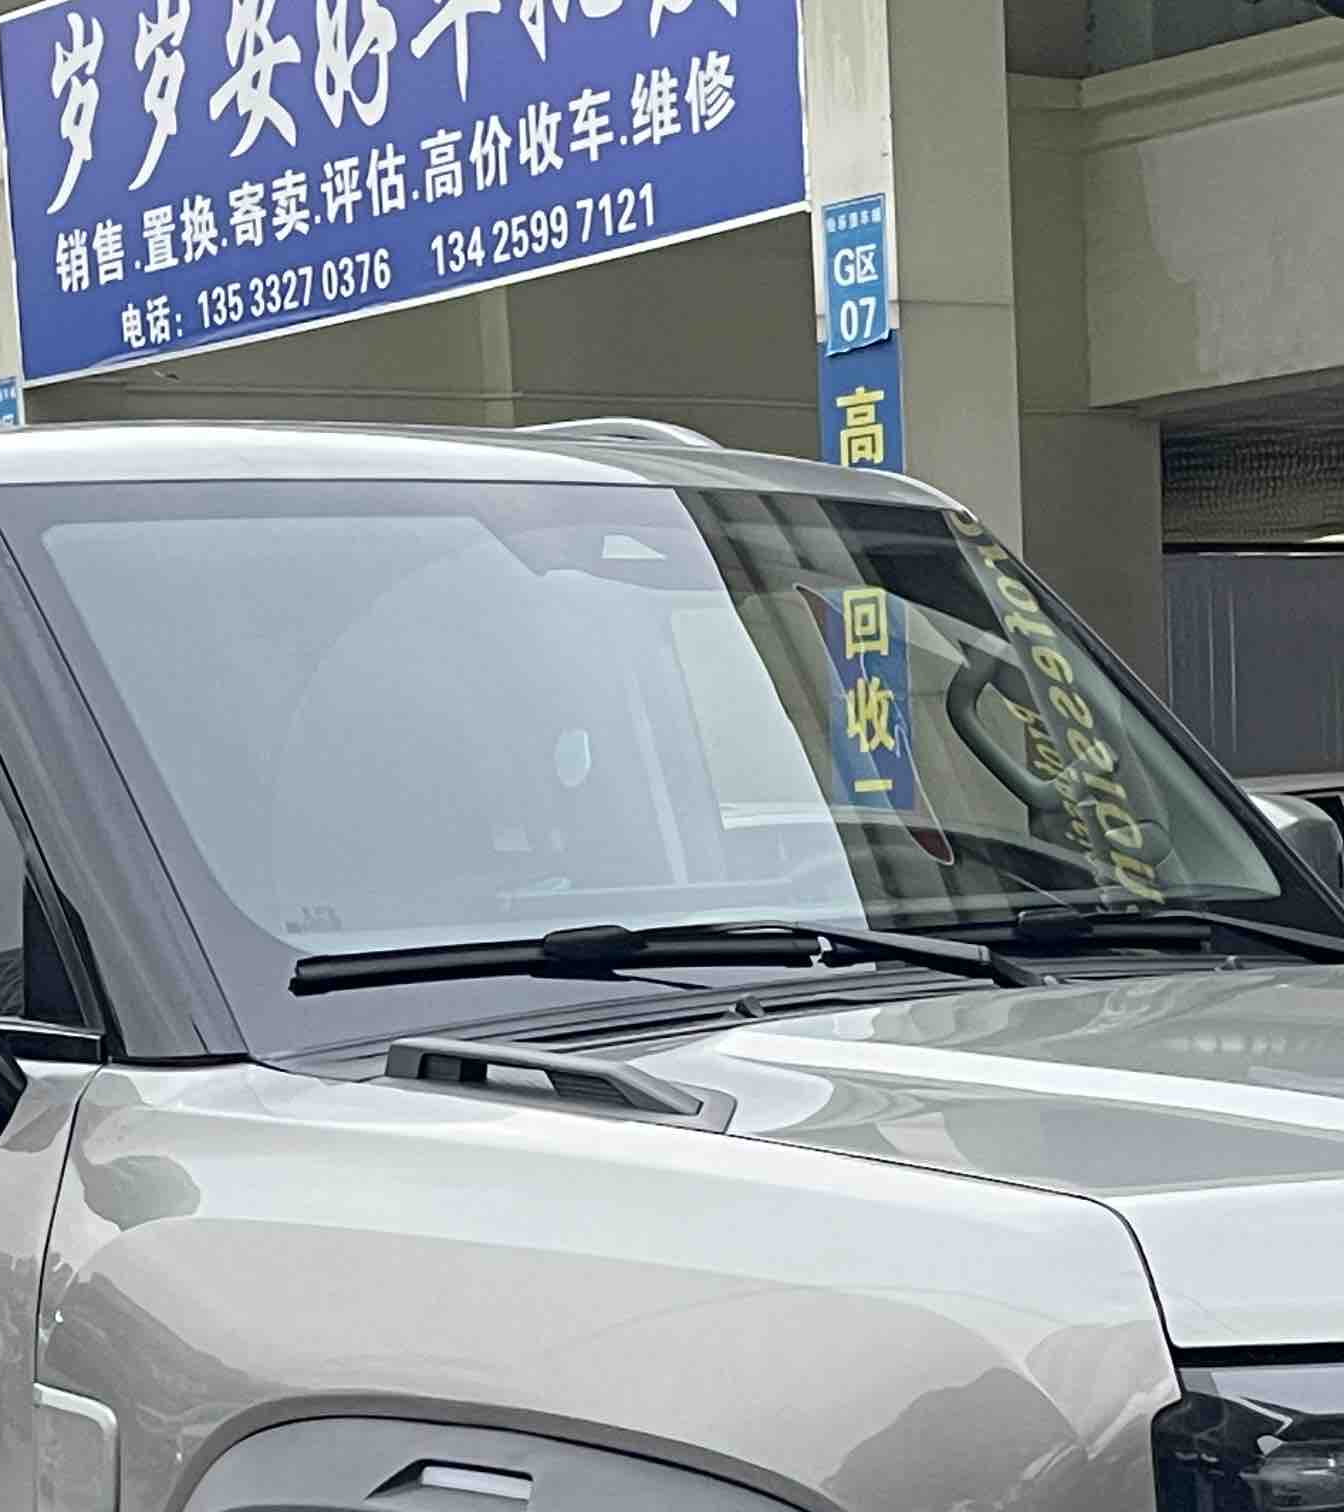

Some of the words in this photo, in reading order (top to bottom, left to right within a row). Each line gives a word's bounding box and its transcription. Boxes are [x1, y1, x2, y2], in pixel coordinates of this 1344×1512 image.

[196, 287, 244, 329] 135
[250, 275, 313, 318] 3327
[321, 258, 392, 303] 0376
[429, 238, 485, 278] 134
[492, 210, 570, 262] 2599
[580, 182, 657, 243] 7121
[833, 243, 878, 287] G区
[839, 296, 877, 343] 07
